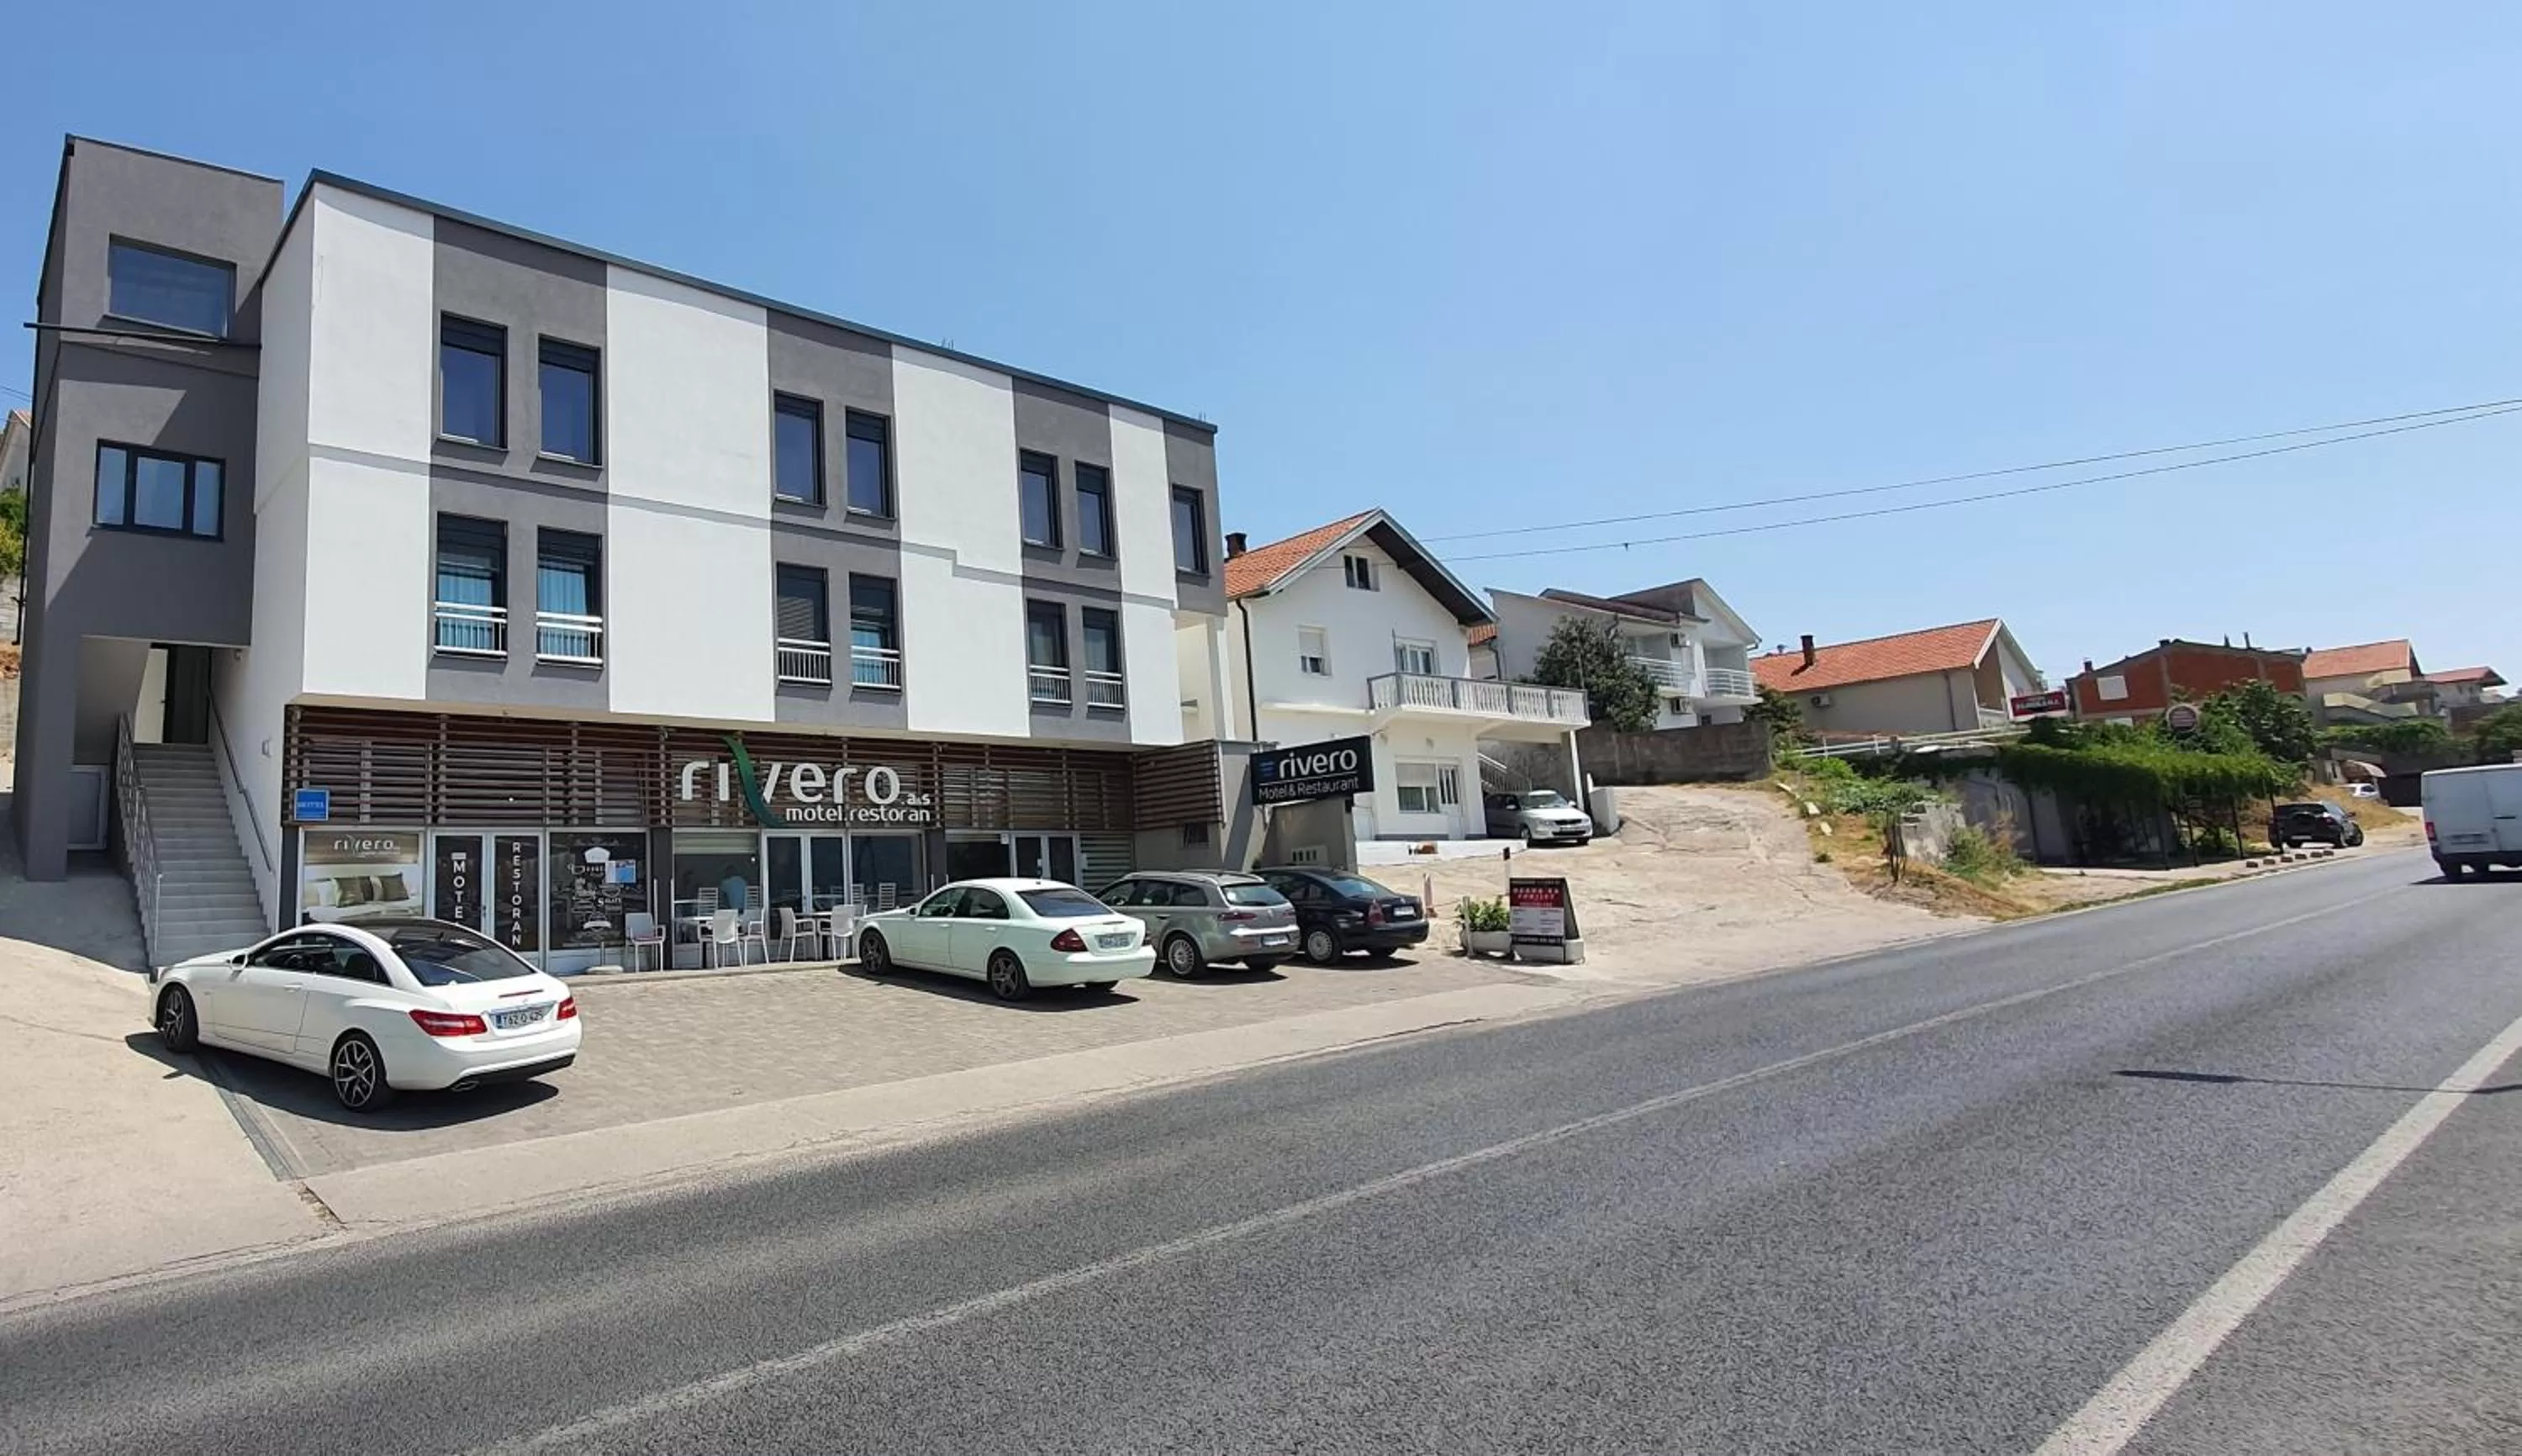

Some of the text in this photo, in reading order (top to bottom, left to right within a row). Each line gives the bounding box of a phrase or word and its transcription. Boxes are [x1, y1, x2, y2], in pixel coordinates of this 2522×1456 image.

[682, 756, 900, 808] rivero
[1258, 784, 1287, 799] Motel
[1297, 777, 1359, 797] Restaurant
[1279, 749, 1358, 779] rivero
[453, 860, 466, 920] MOTE
[511, 841, 522, 946] RESTORAN
